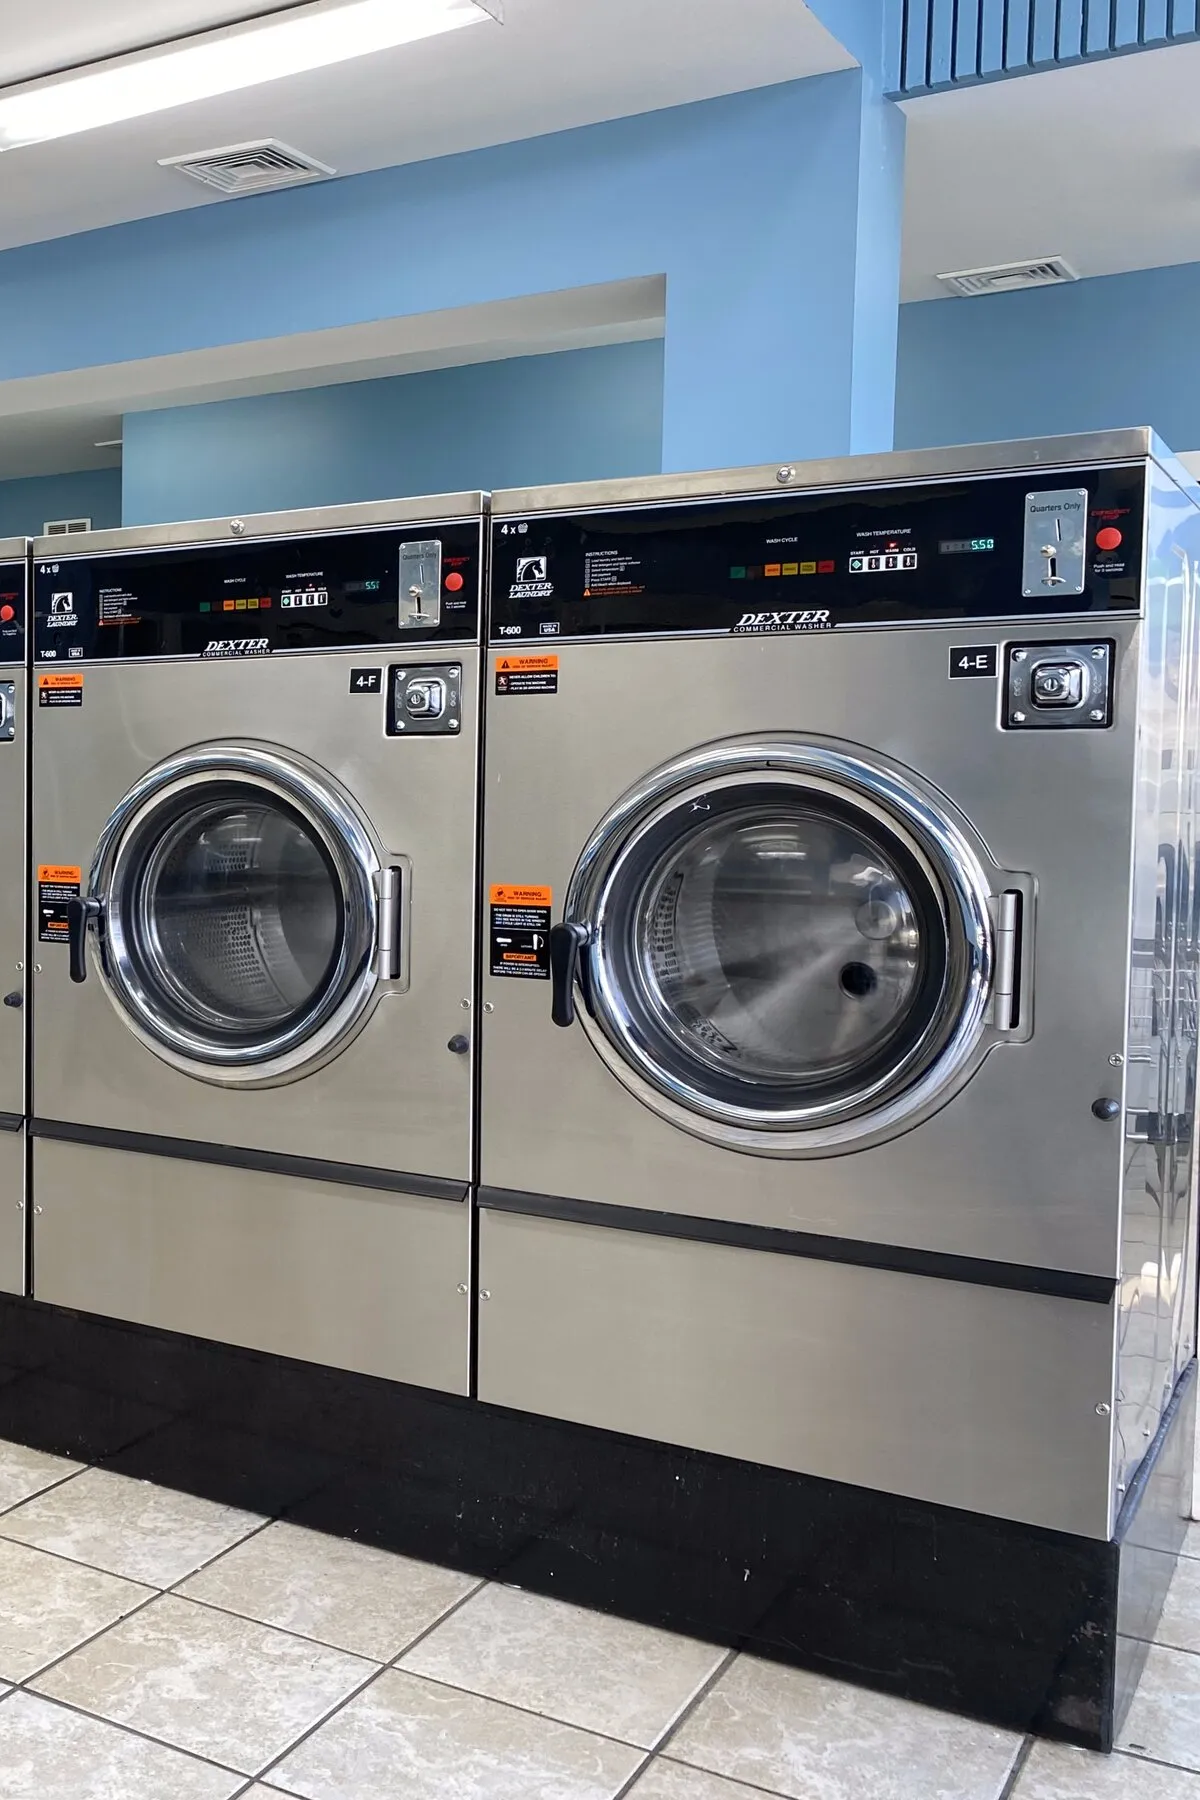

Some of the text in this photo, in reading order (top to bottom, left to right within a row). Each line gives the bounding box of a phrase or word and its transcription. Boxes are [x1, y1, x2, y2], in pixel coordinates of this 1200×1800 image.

[1030, 502, 1081, 513] Quarters Only
[500, 524, 516, 535] 4 x
[872, 528, 912, 536] TEMPERATURE
[40, 564, 46, 574] 4
[509, 582, 552, 592] DEXTER
[508, 590, 553, 598] LAUNDRY
[47, 614, 76, 622] DEXTER
[736, 610, 830, 626] DEXTER
[498, 626, 522, 635] T-600
[734, 624, 791, 632] COMMERCIAL
[204, 639, 269, 651] DEXTER
[958, 655, 988, 670] 4-E
[356, 675, 376, 687] 4-F
